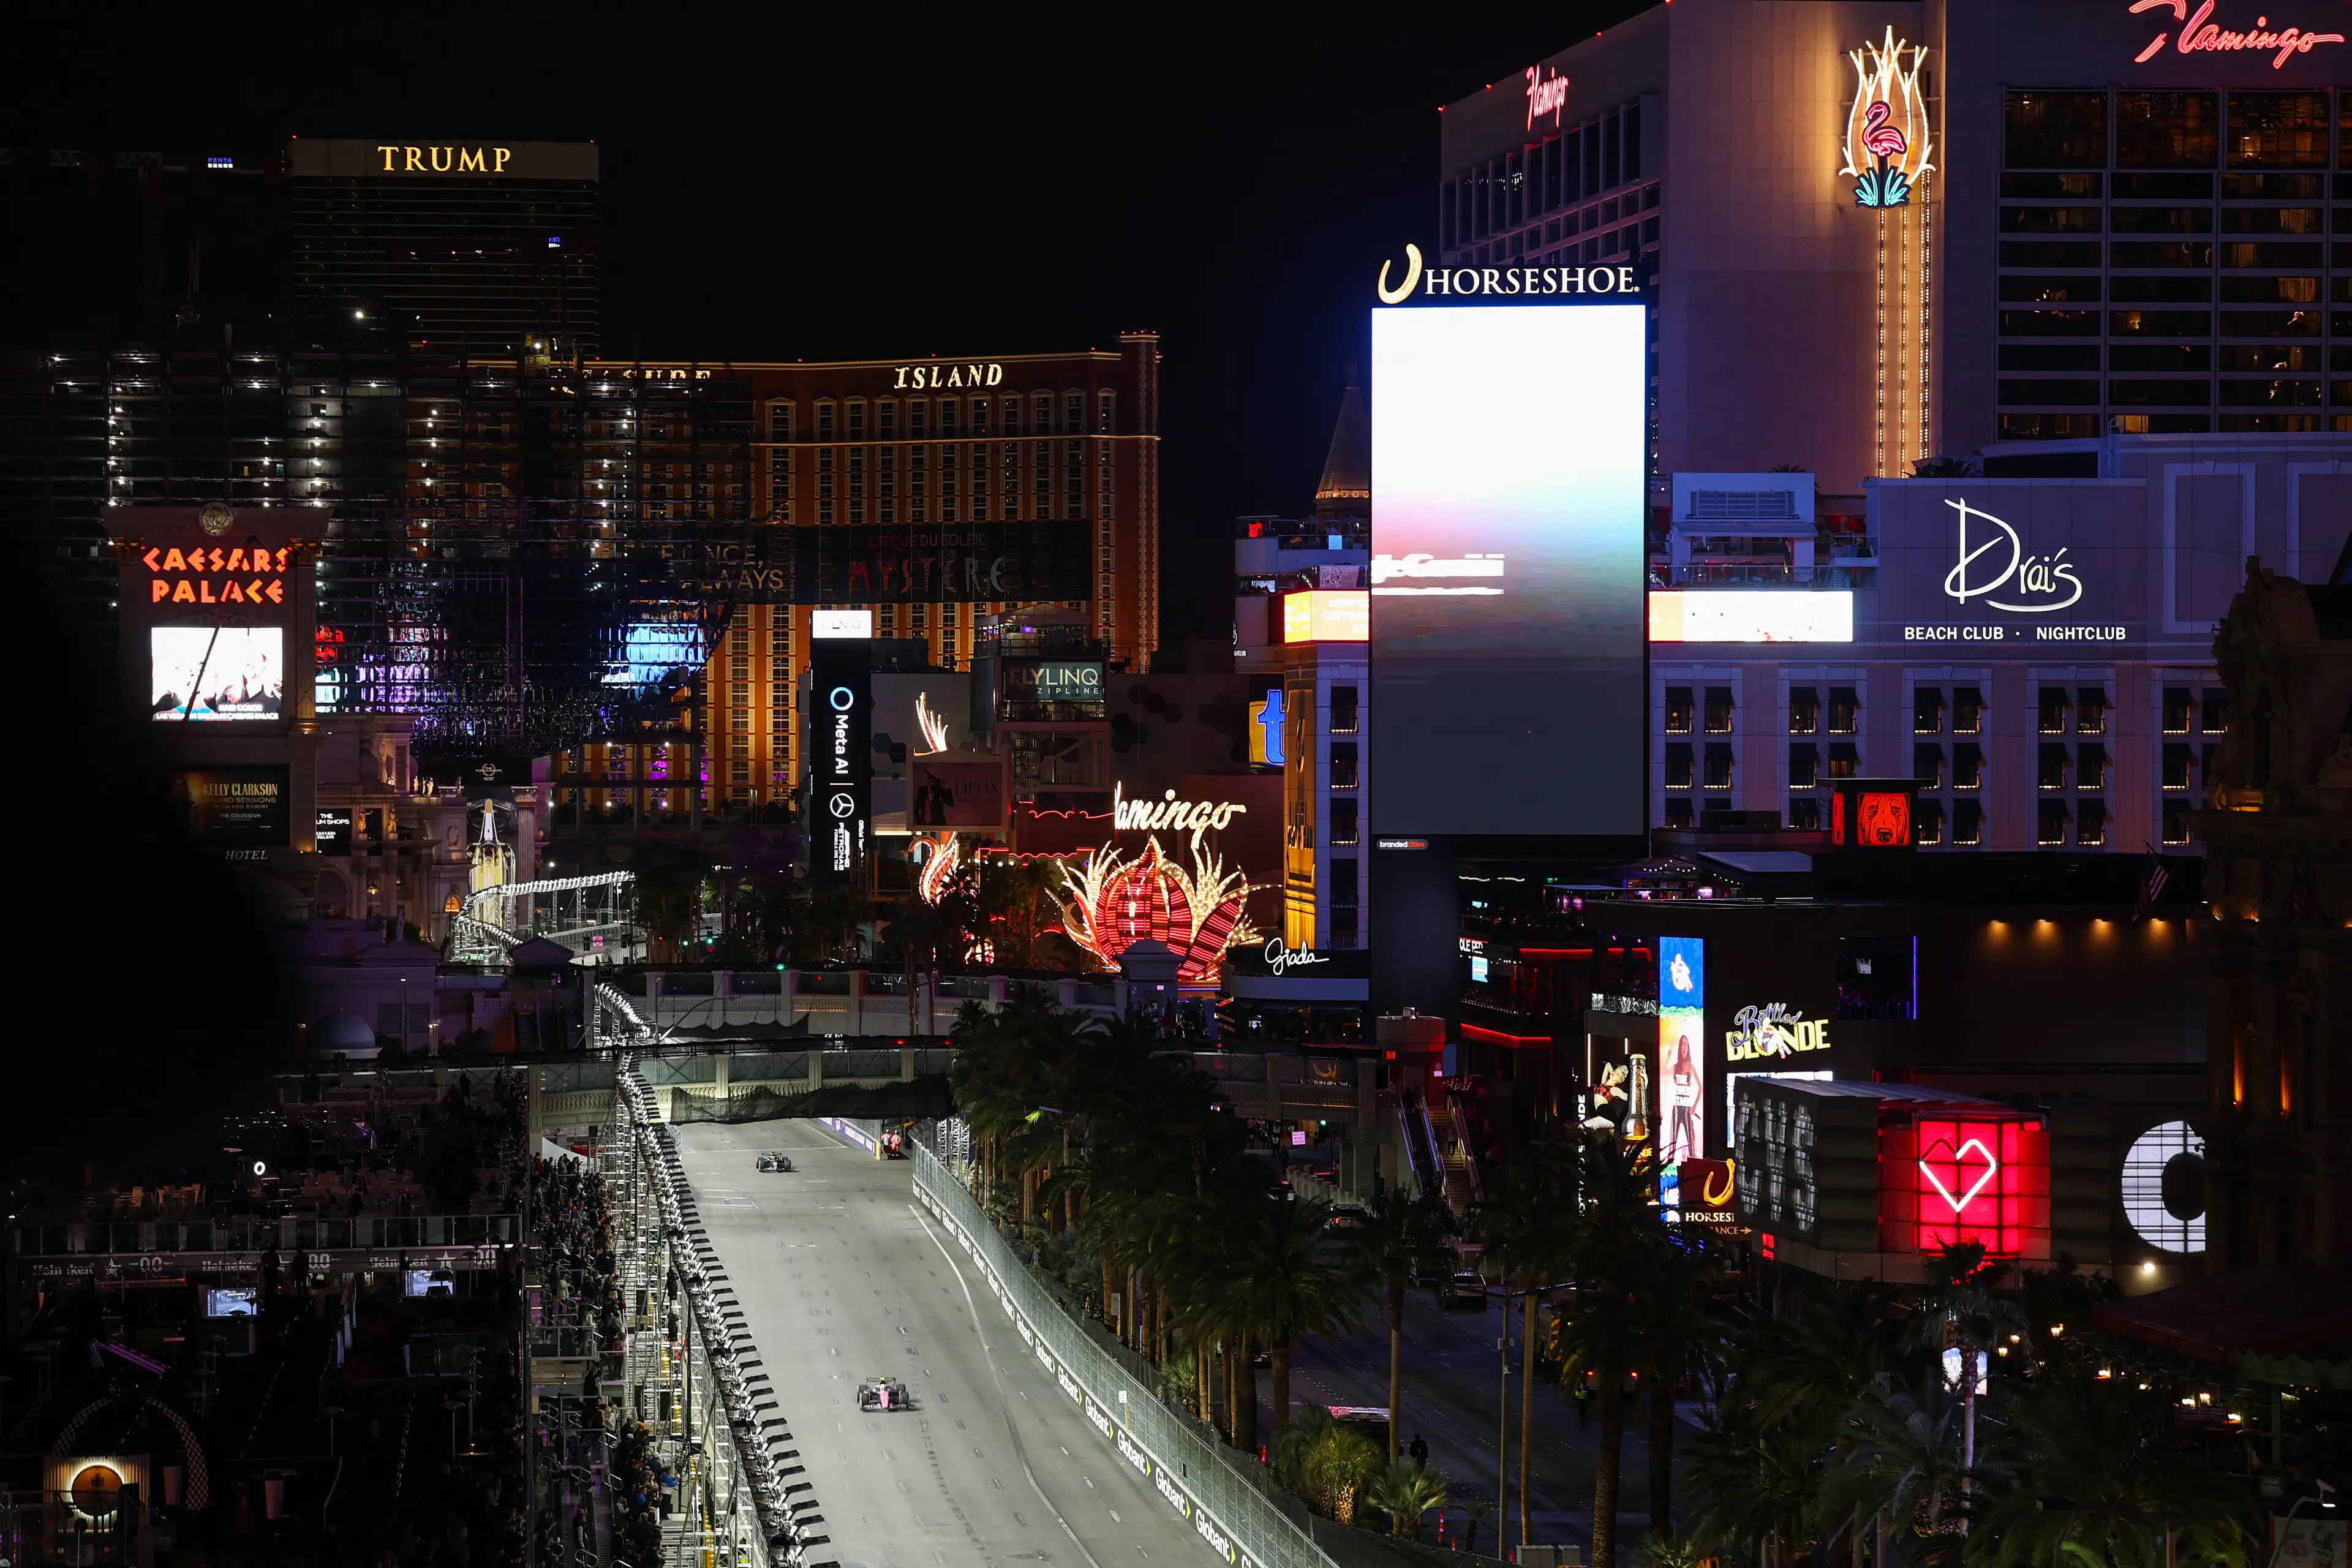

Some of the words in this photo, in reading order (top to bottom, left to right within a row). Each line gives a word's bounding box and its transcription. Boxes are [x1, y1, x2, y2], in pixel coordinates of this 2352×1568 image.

[2128, 0, 2345, 70] Flamingo
[1526, 65, 1569, 131] Flamingo
[378, 146, 512, 172] TRUMP
[1425, 266, 1634, 295] HORSESHOE
[893, 363, 1003, 391] ISLAND
[143, 546, 288, 573] CAESARS
[1943, 497, 2082, 612] Drai's
[152, 578, 284, 604] PALACE
[1904, 626, 1957, 640] BEACH
[1962, 626, 2004, 640] CLUB
[2037, 626, 2126, 640] NIGHTCLUB
[1009, 668, 1098, 686] FLYLINQ
[835, 714, 850, 755] Meta
[835, 757, 850, 774] AI
[203, 783, 228, 796] KELLY
[231, 783, 278, 796] CLARKSON
[225, 850, 268, 860] HOTEL
[1265, 937, 1330, 975] Giada
[1731, 1002, 1803, 1048] Bottled
[1035, 1338, 1053, 1374] Globant
[1058, 1365, 1079, 1404] Globant
[1085, 1395, 1110, 1438] Globant
[1117, 1429, 1147, 1475] Globant
[1155, 1467, 1186, 1517] Globant
[1195, 1509, 1231, 1562] Globant
